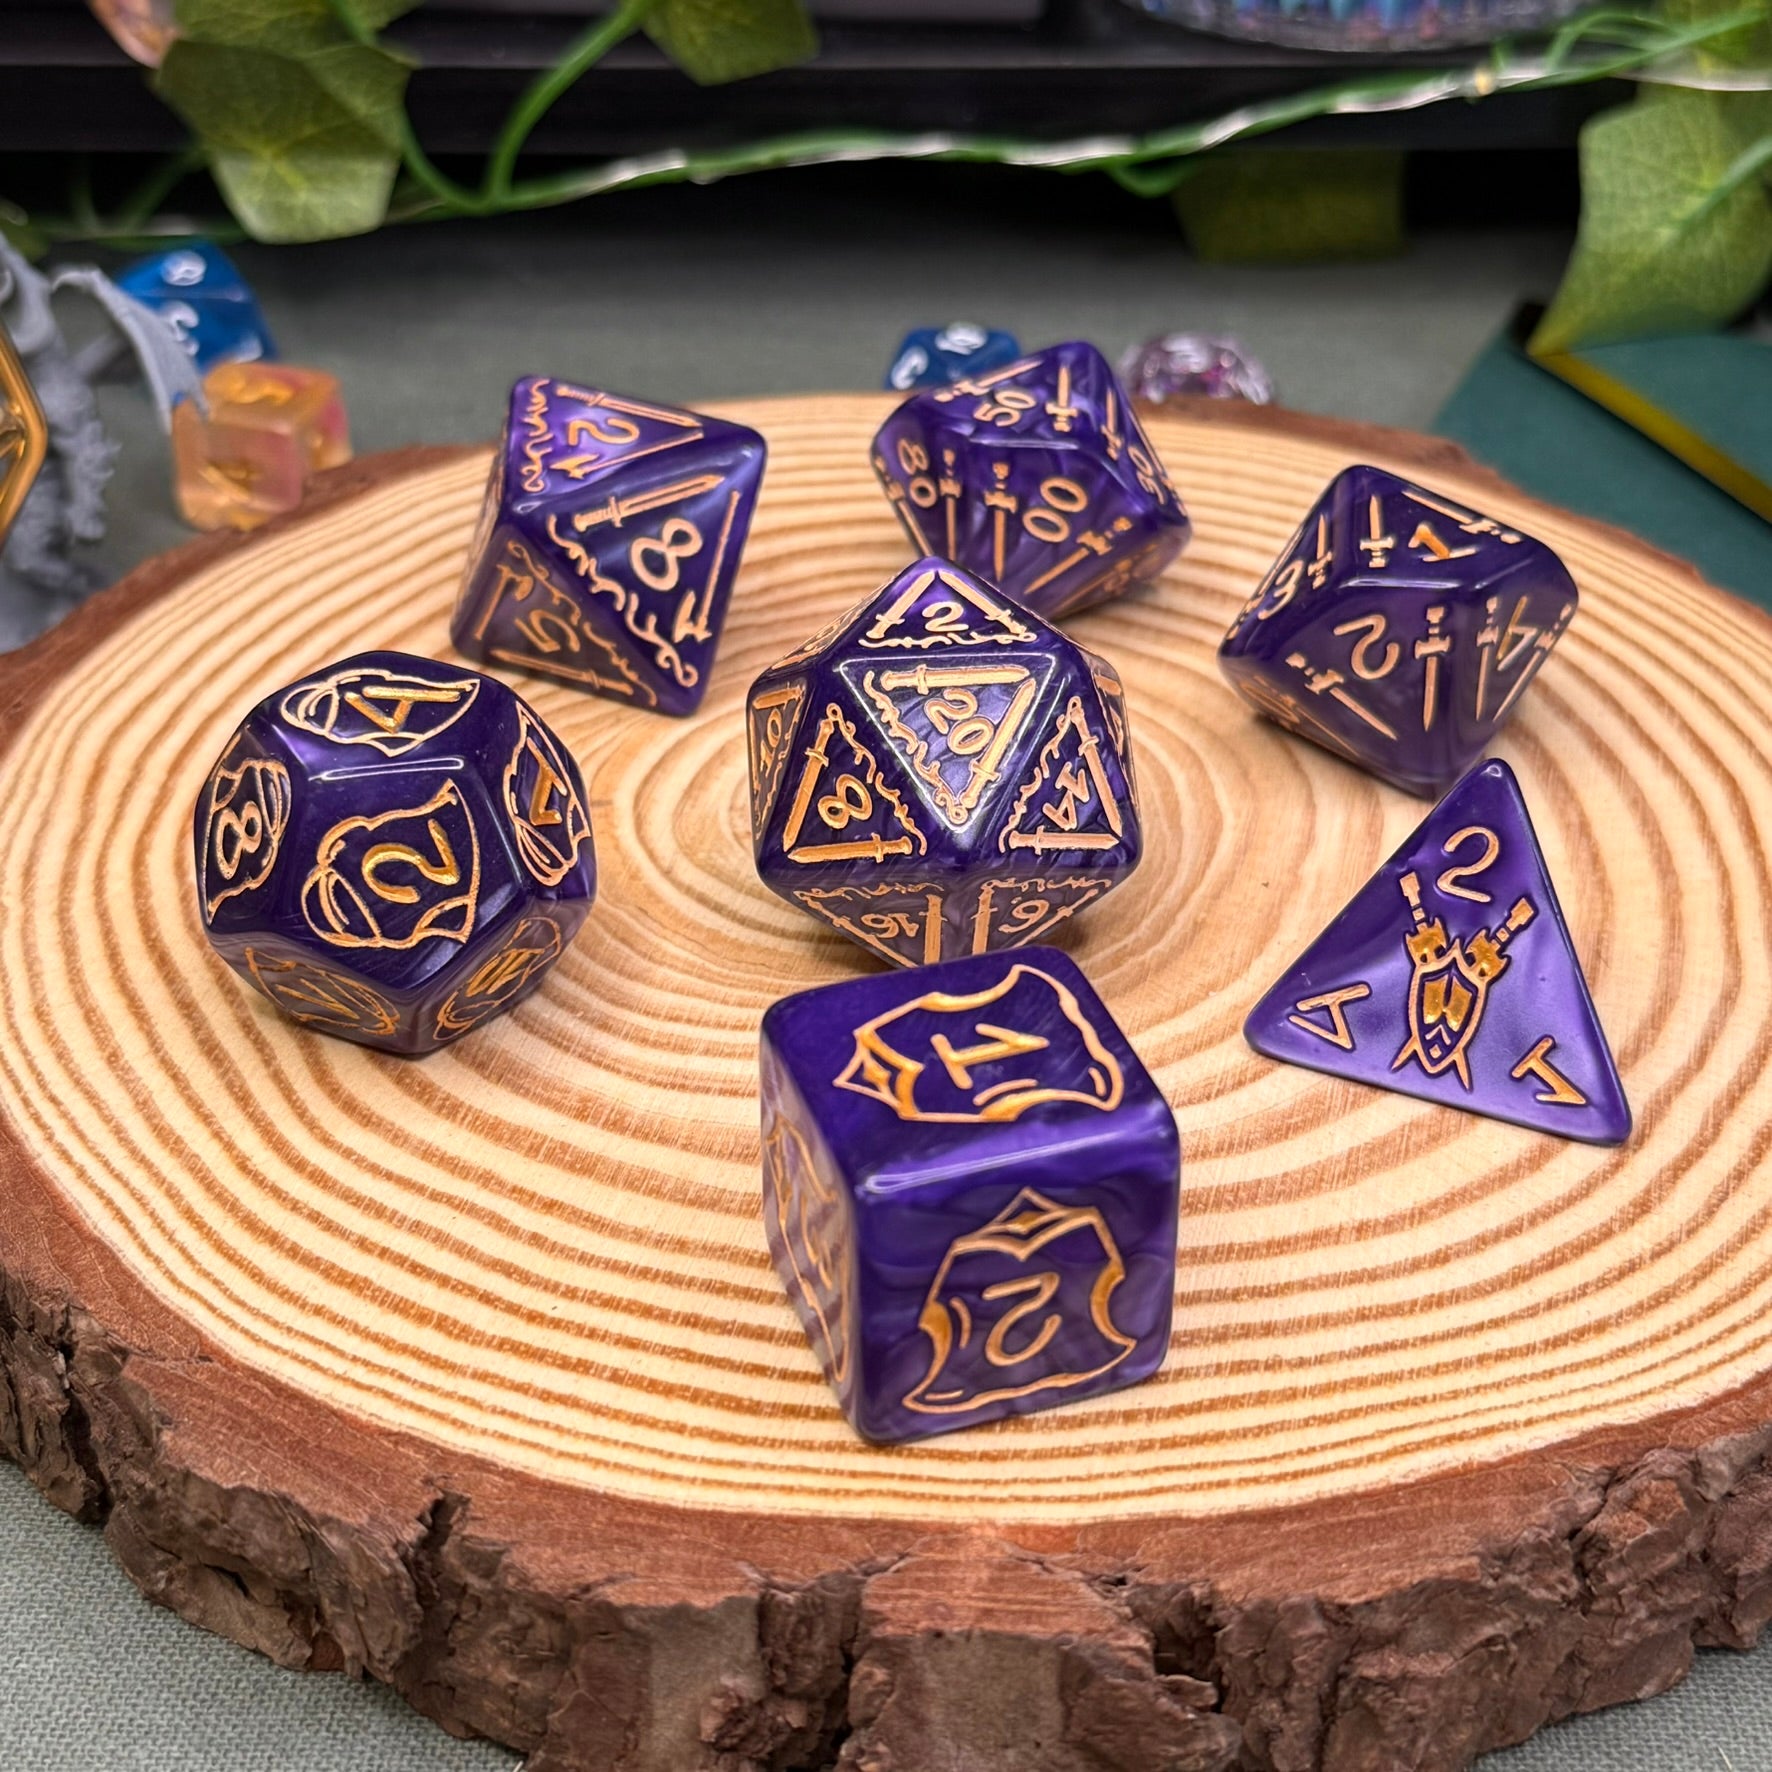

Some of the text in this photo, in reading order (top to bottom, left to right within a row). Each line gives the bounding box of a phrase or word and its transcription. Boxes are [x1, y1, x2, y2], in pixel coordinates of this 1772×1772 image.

[568, 417, 640, 446] 2
[973, 389, 1037, 427] 50
[897, 438, 938, 509] 80
[1022, 476, 1089, 543] 00
[1408, 522, 1479, 563] 1
[630, 517, 703, 592] 8
[922, 601, 970, 632] 2
[1258, 559, 1304, 621] 3
[1332, 613, 1400, 681] 2
[924, 687, 996, 756] 20
[817, 773, 873, 829] 8
[215, 800, 263, 880] 8
[361, 818, 460, 904] 2
[1435, 825, 1500, 903] 2
[930, 1022, 1051, 1091] 1
[981, 1271, 1062, 1367] 2
